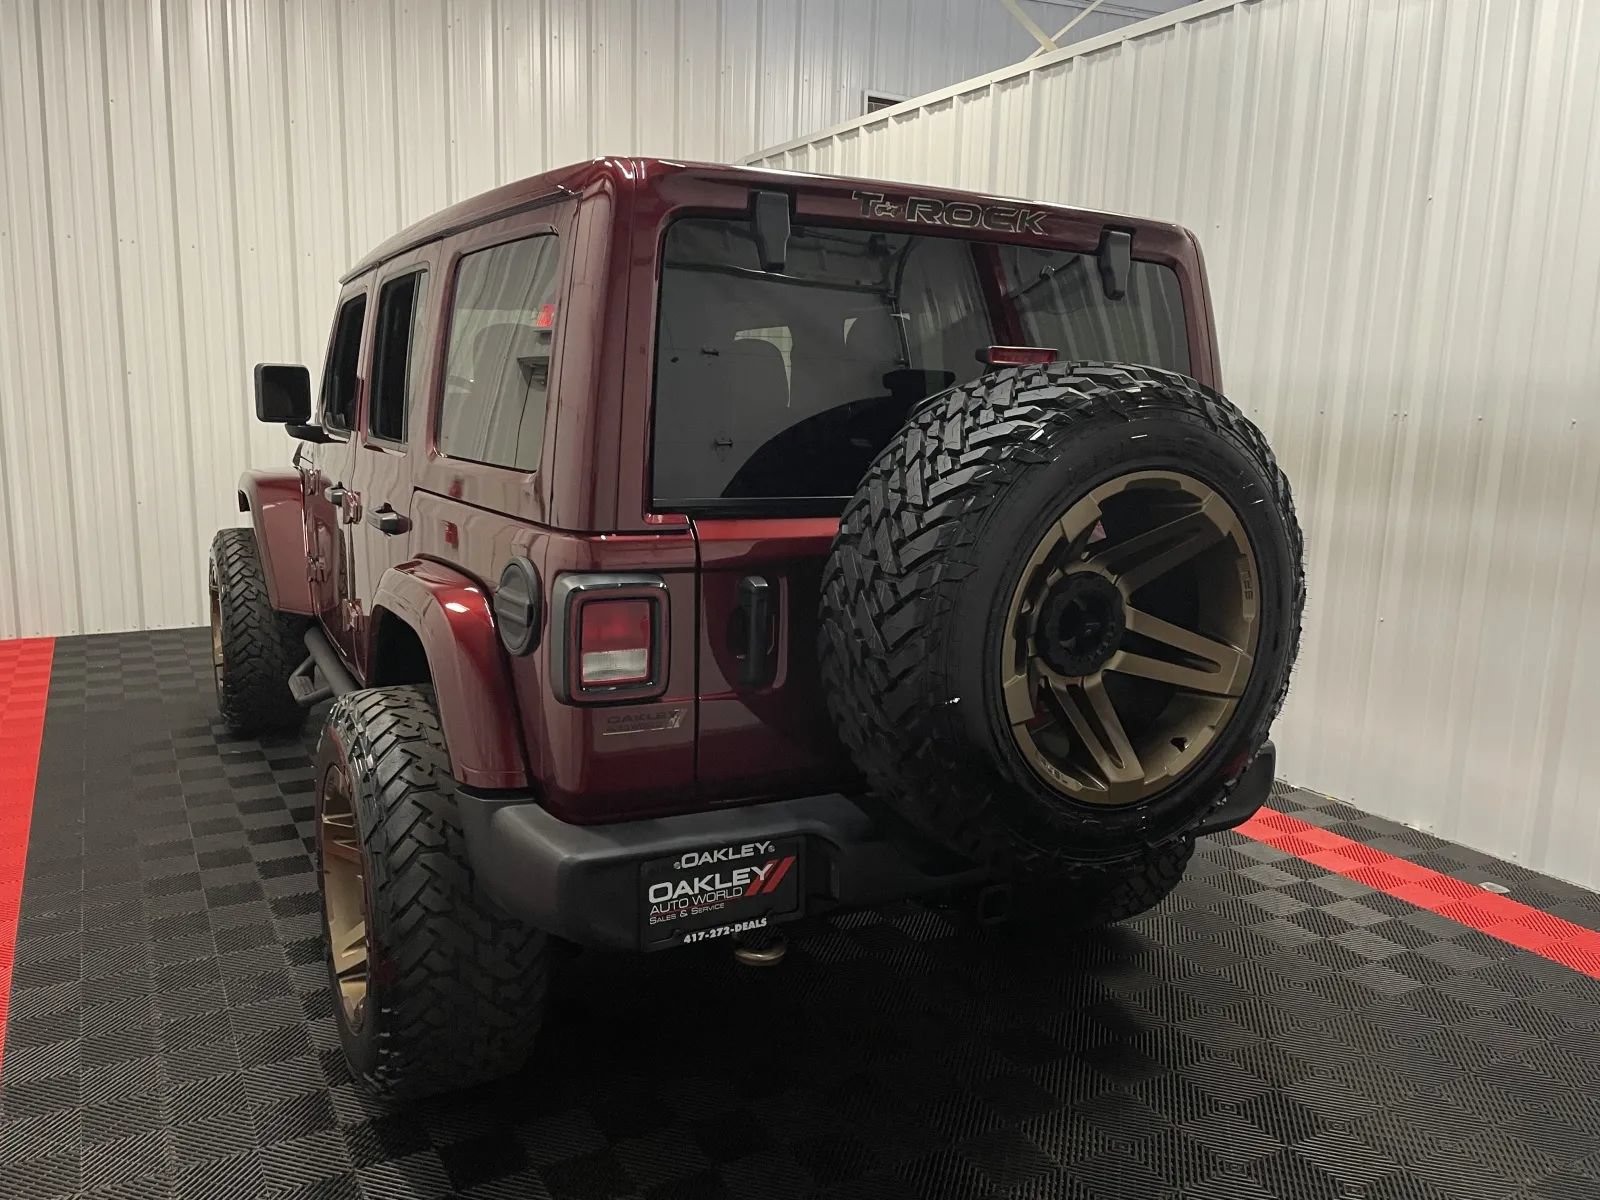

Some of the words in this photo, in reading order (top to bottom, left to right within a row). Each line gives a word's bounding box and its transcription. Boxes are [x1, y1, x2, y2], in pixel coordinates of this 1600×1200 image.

[681, 840, 771, 869] OAKLEY
[648, 863, 773, 904] OAKLEY
[650, 897, 689, 916] AUTO
[691, 886, 743, 906] WORLD
[679, 908, 688, 918] &
[683, 917, 767, 944] 417-272-DEALS
